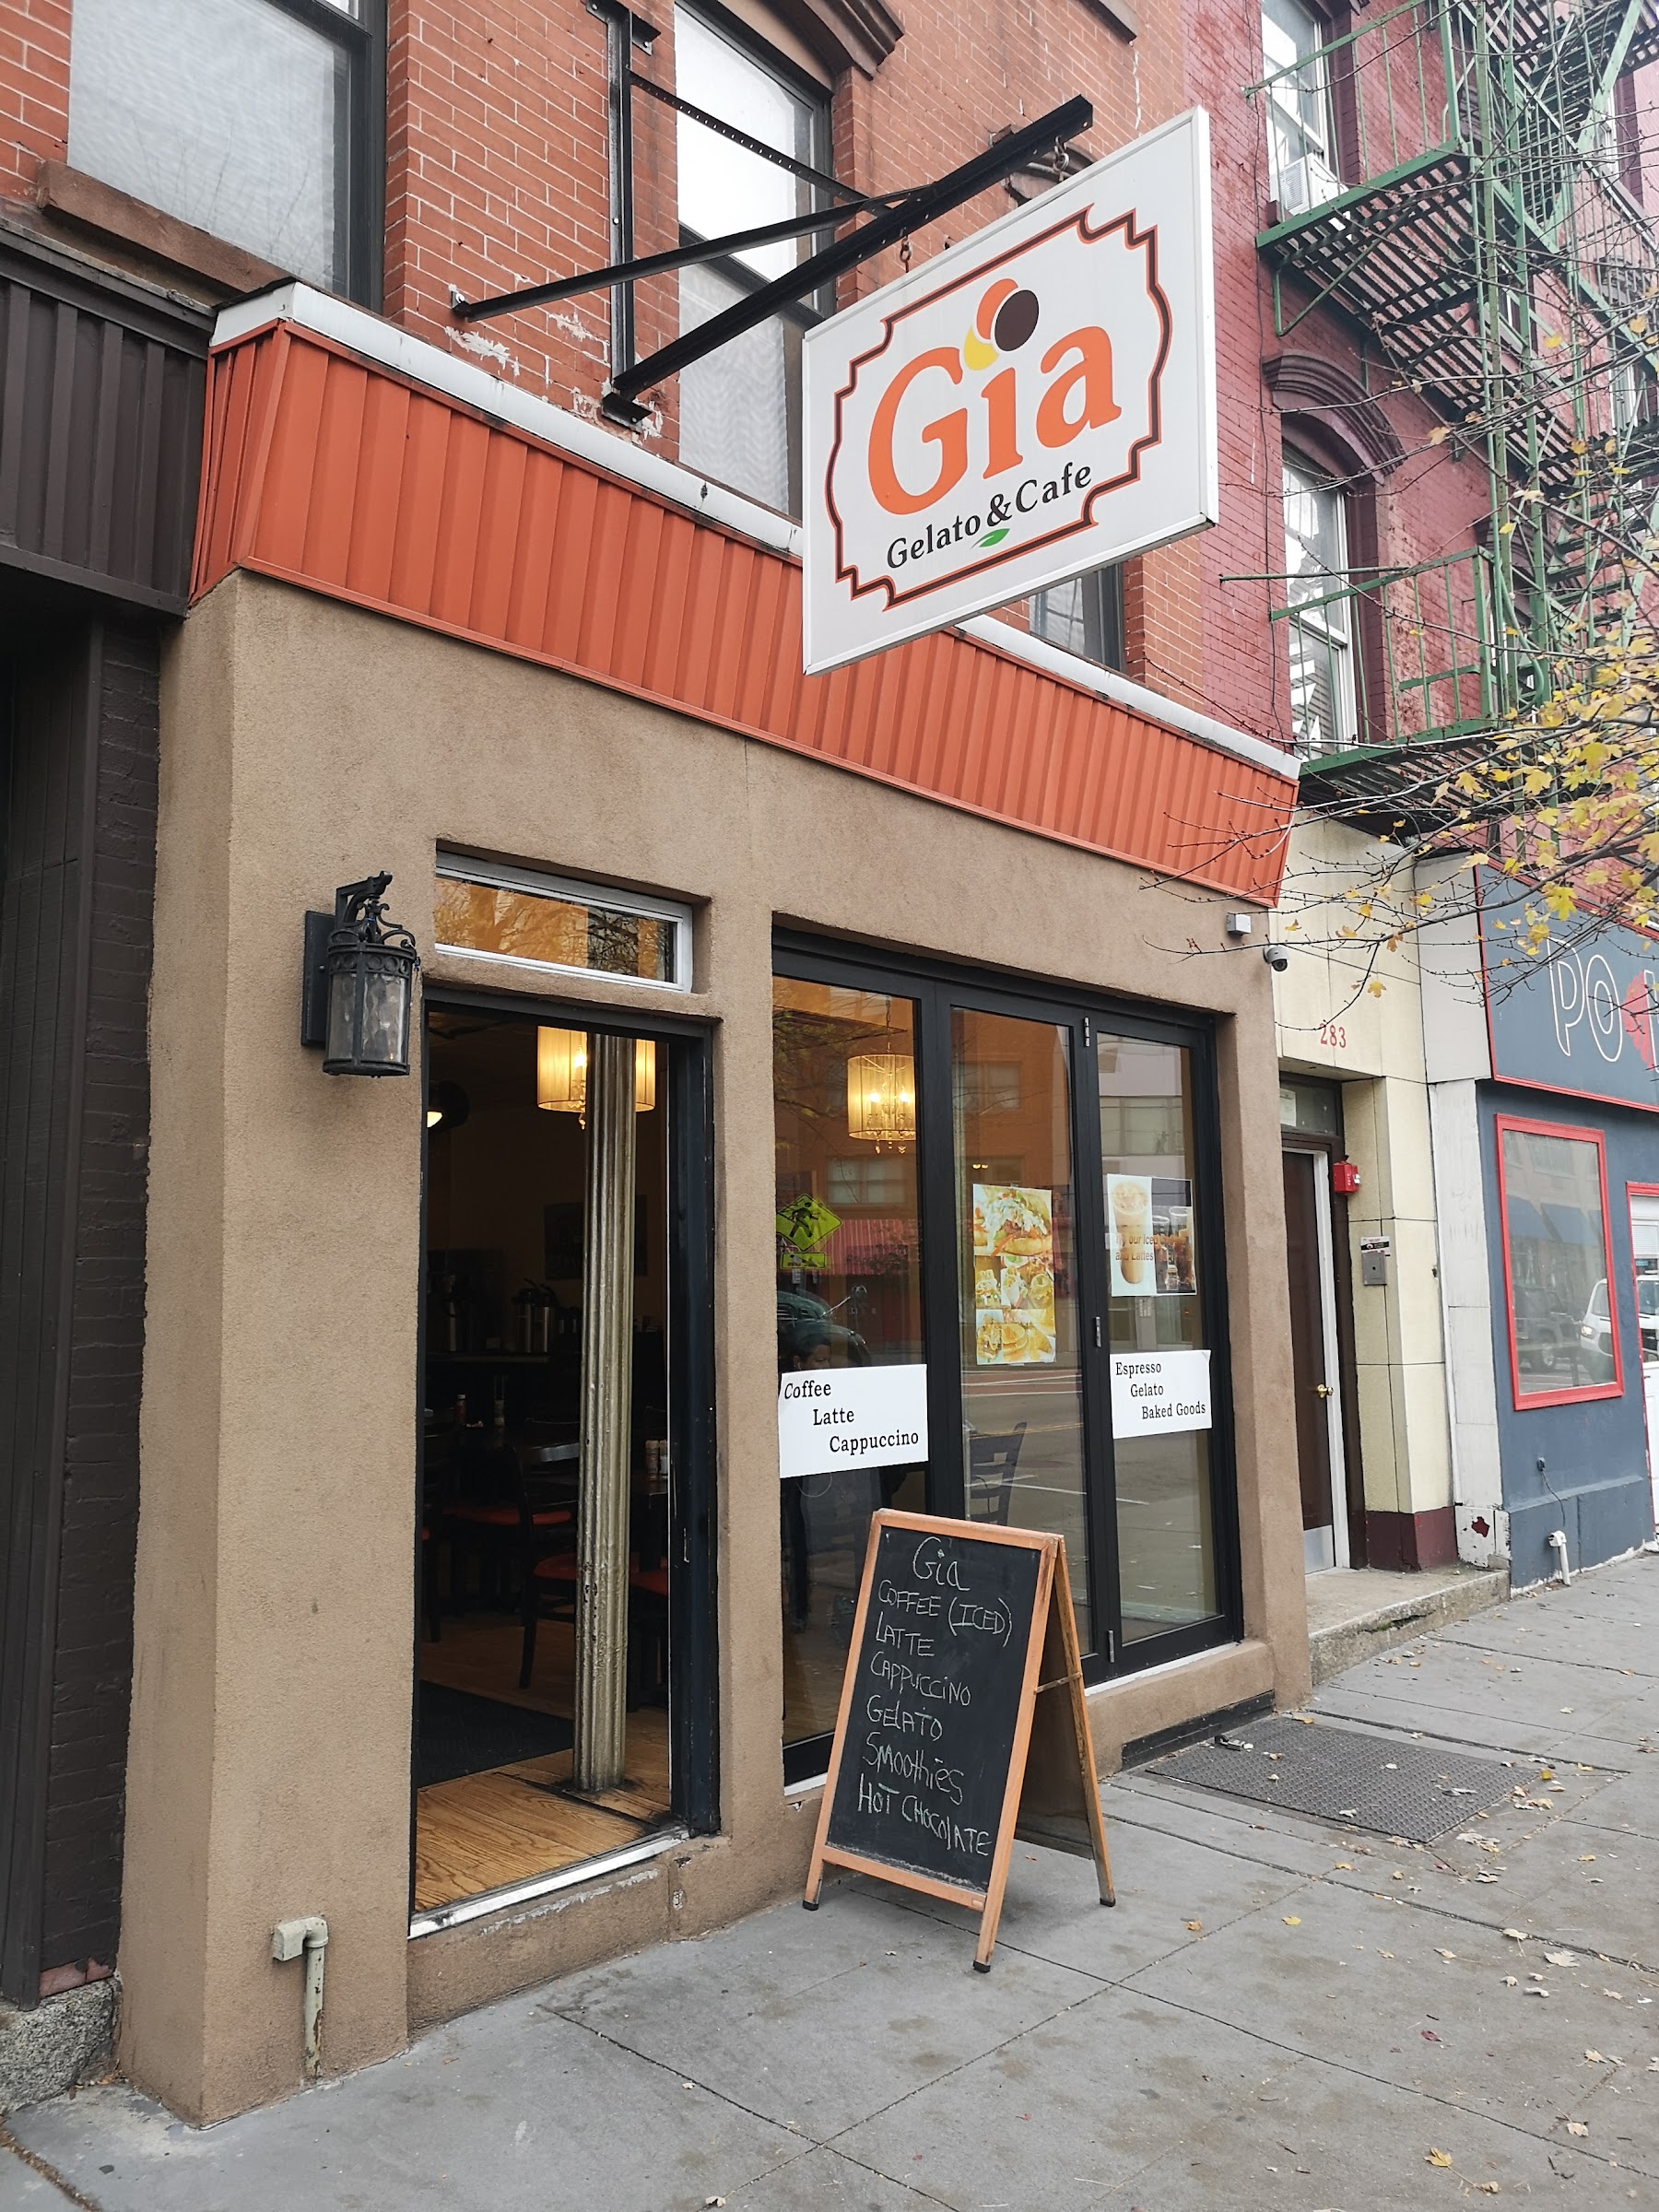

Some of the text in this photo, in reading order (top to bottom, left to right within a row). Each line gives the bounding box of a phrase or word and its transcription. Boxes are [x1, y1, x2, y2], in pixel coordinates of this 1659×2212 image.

[867, 324, 1123, 516] Gia
[1319, 1022, 1347, 1048] 283
[1115, 1361, 1161, 1379] Espresso
[784, 1380, 831, 1399] Coffee
[1130, 1382, 1164, 1397] Gelato
[813, 1407, 855, 1426] Latte
[1141, 1400, 1206, 1419] Baked Goods
[830, 1430, 919, 1456] Cappuccino
[912, 1535, 971, 1591] Gia
[877, 1579, 942, 1617] COFFEE
[876, 1611, 935, 1657] LATTE
